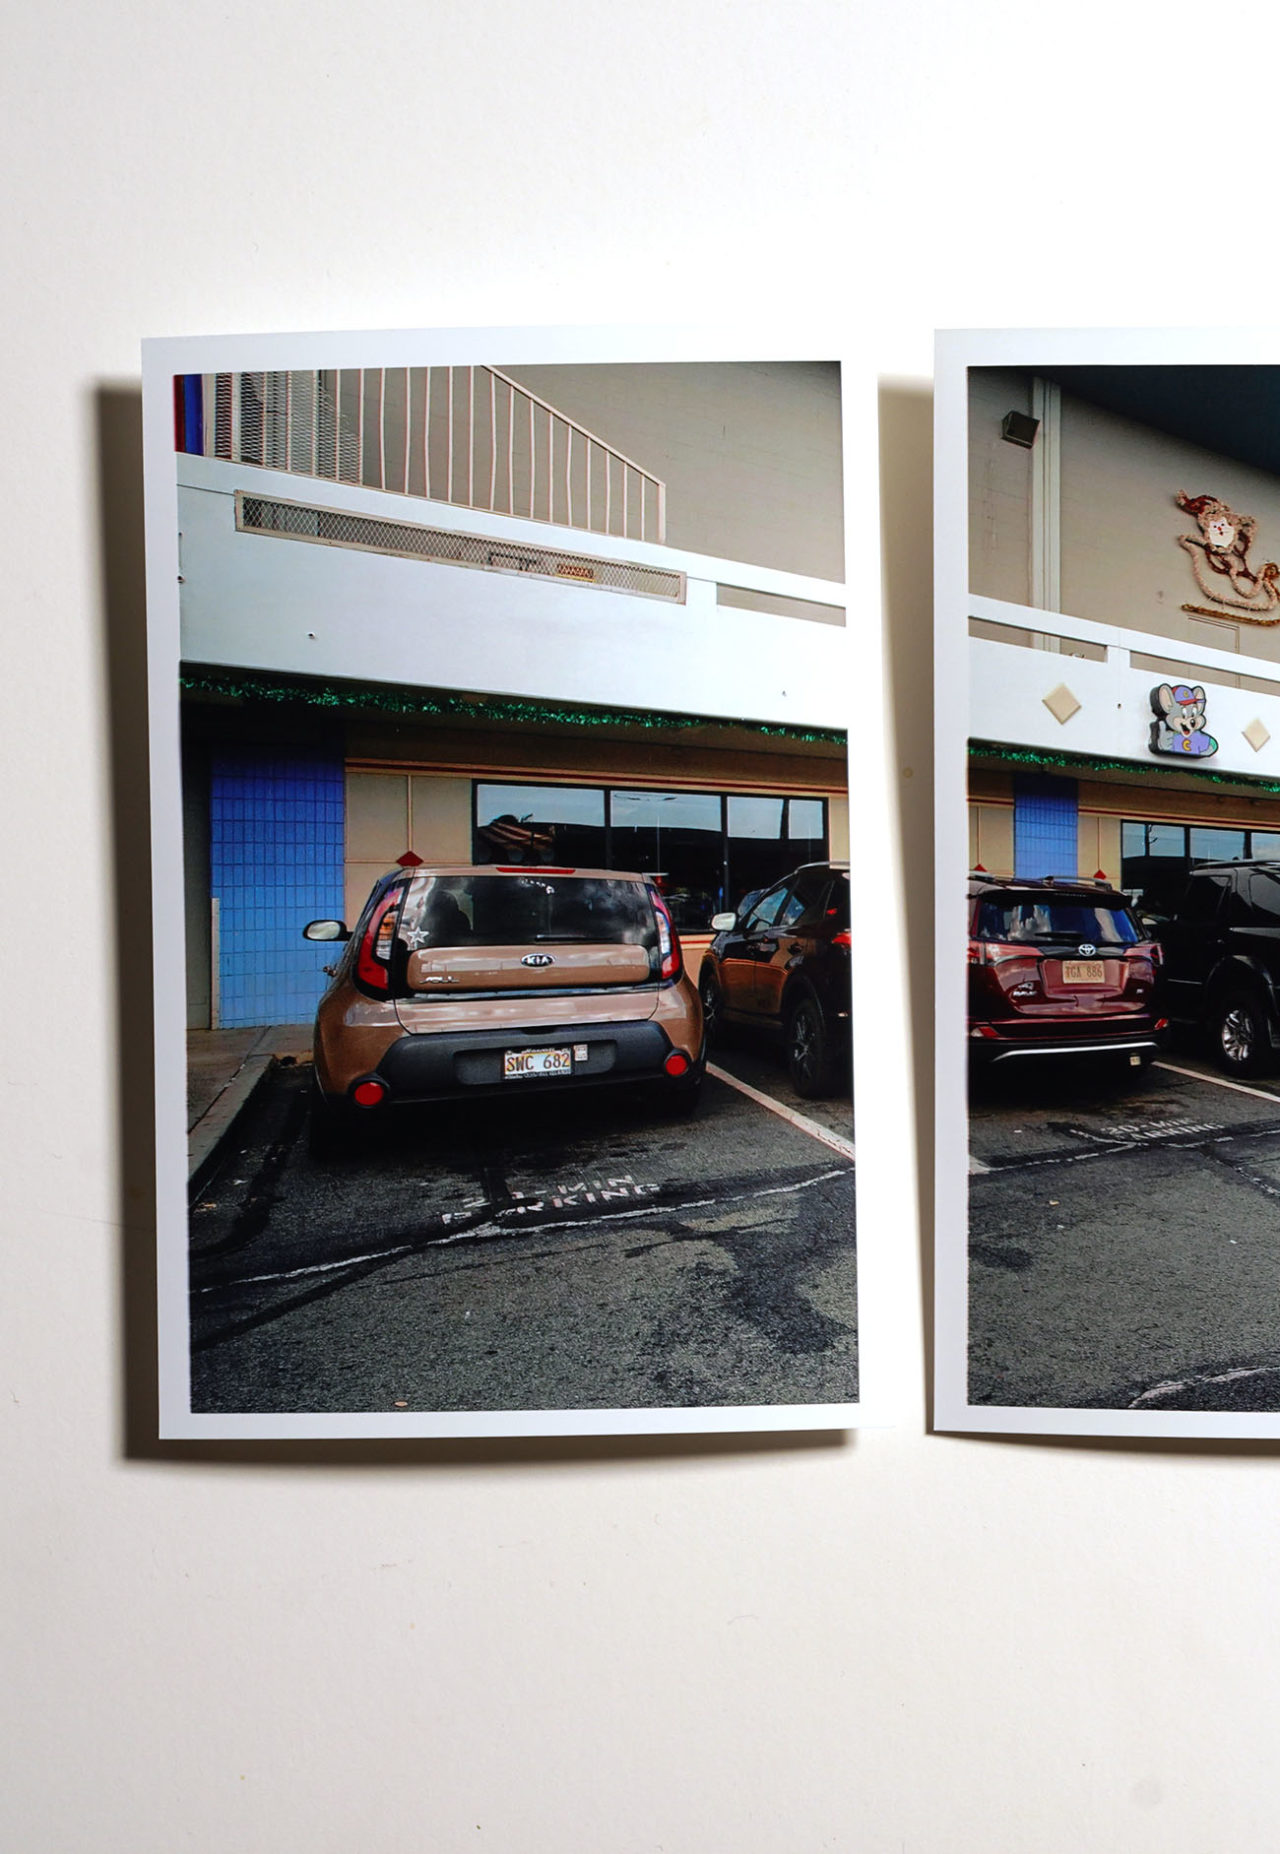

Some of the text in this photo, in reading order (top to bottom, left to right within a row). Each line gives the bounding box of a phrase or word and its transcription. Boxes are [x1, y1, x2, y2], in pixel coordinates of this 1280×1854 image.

[1182, 738, 1192, 752] C
[526, 955, 549, 965] KIA
[1065, 964, 1103, 979] TGA 886
[506, 1055, 534, 1072] SWC
[543, 1052, 570, 1069] 682
